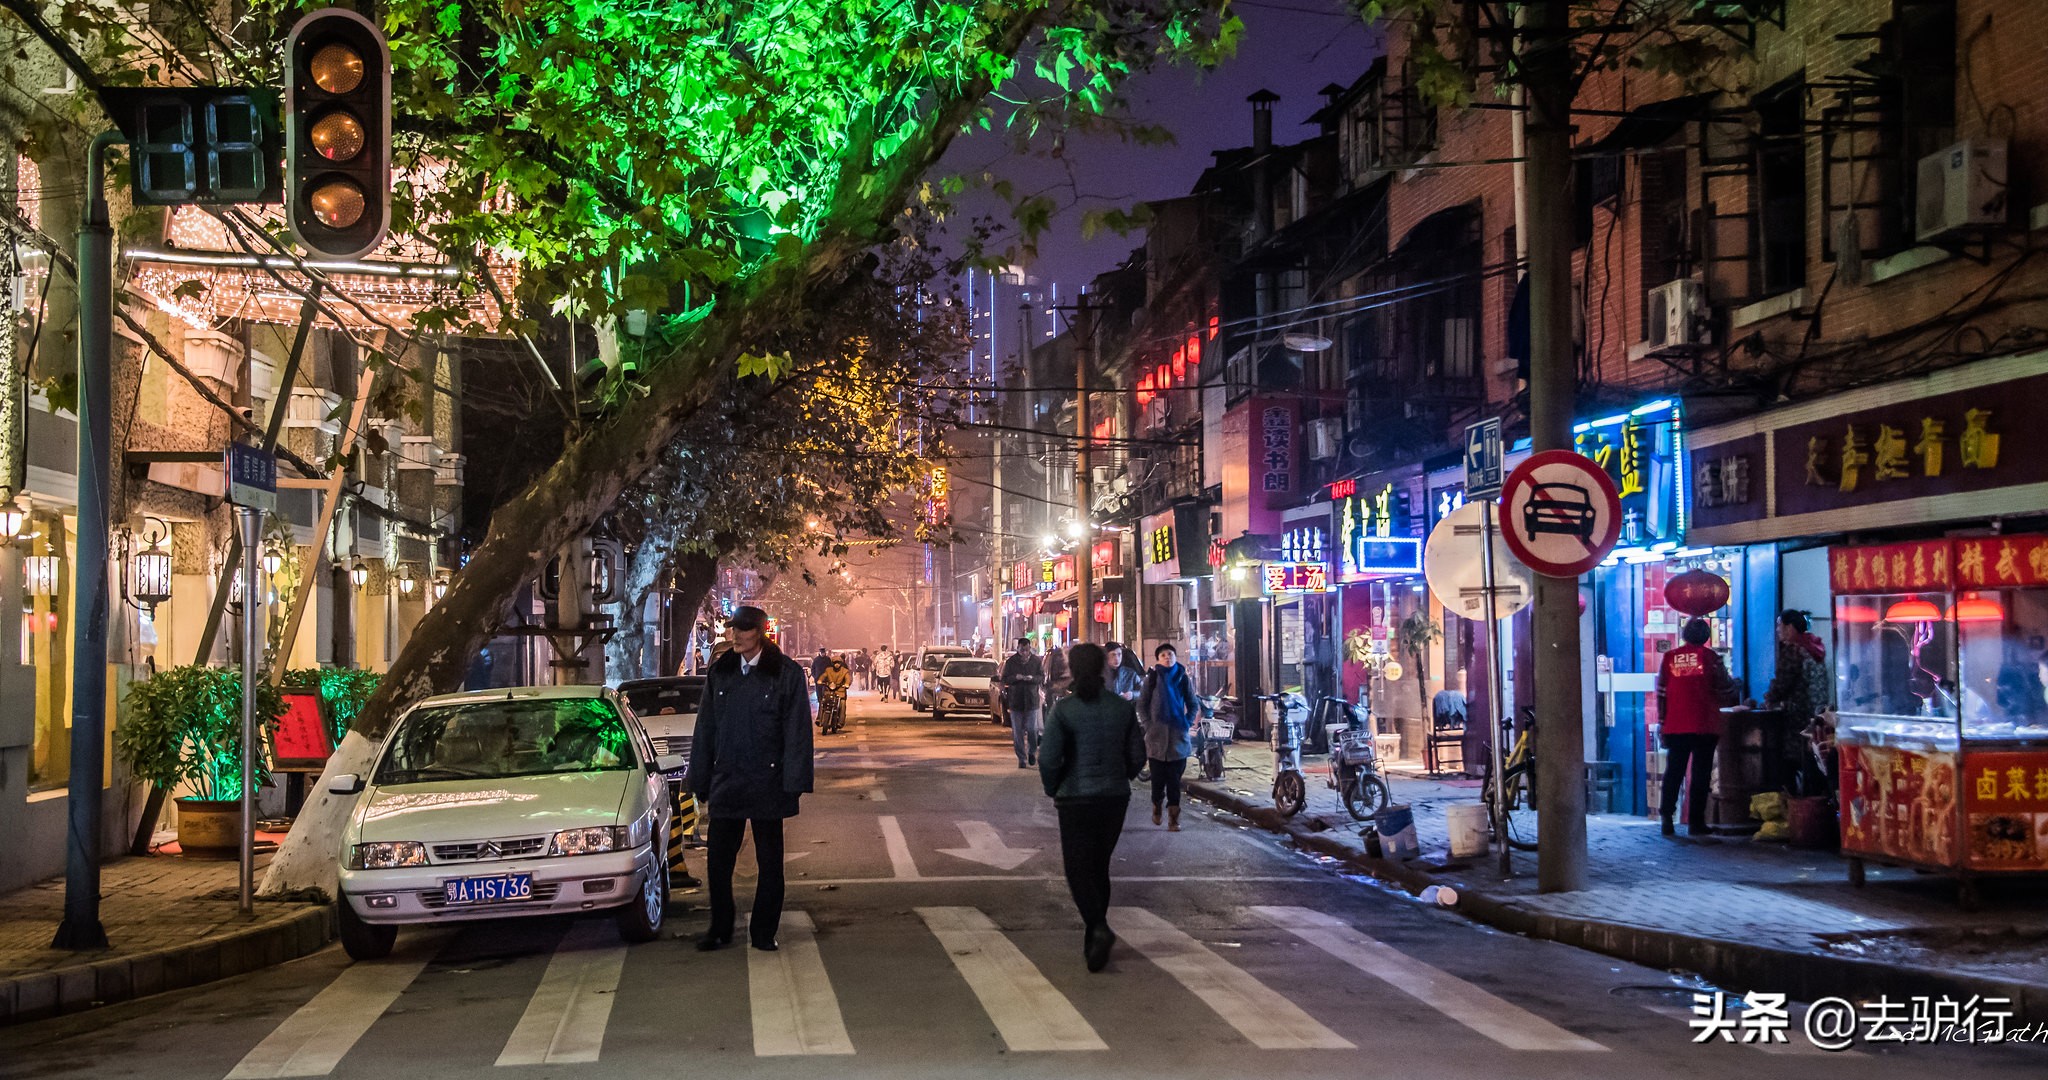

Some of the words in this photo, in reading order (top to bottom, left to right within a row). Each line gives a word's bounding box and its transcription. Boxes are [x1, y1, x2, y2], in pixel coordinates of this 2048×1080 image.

[1269, 566, 1324, 592] 爱上汤
[446, 877, 531, 901] 鄂A·HS736
